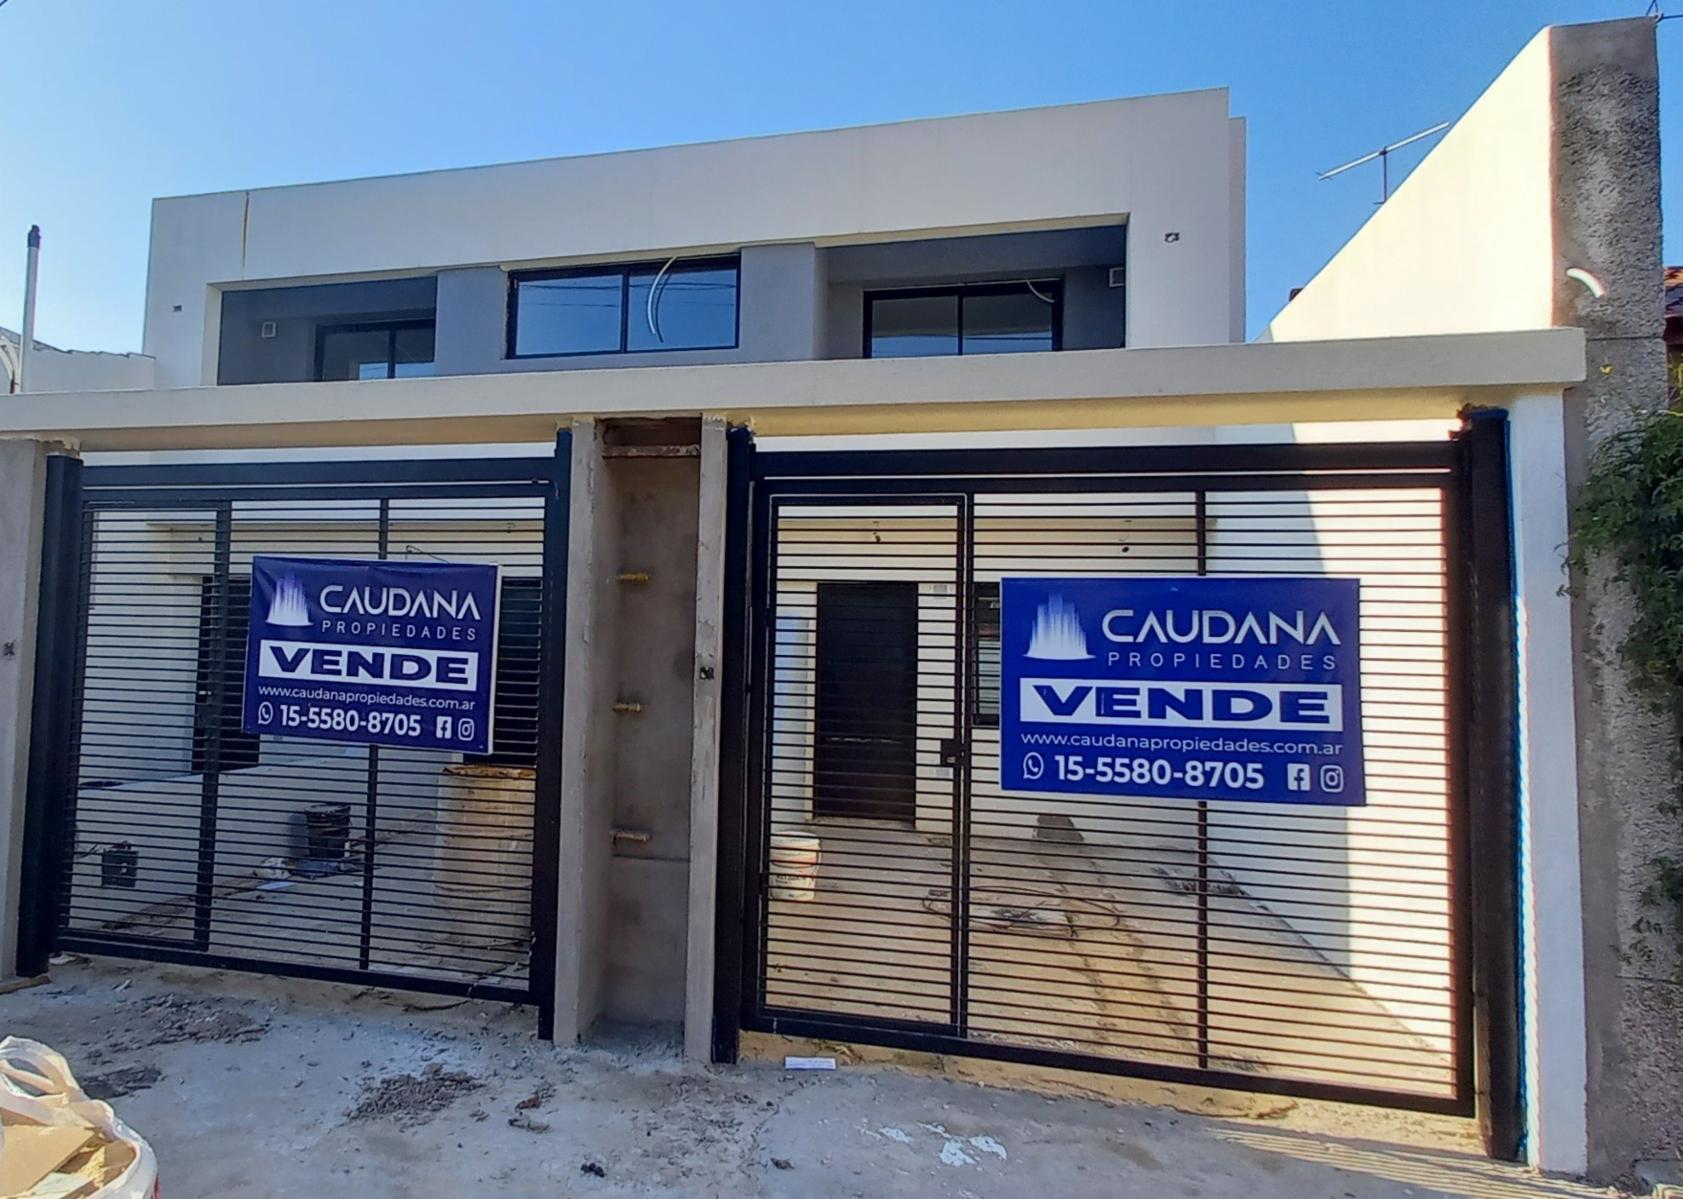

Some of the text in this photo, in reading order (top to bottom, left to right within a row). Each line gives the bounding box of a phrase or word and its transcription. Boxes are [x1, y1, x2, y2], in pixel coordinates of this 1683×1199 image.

[319, 585, 480, 620] CAUDANA
[321, 620, 477, 641] PROPIEDADES
[1102, 609, 1341, 645] CAUDANA
[269, 645, 470, 685] VENDE
[1108, 652, 1336, 670] PROPIEDADES
[258, 685, 475, 711] www.caudanapropiedades.com.ar
[1033, 685, 1330, 724] VENDE
[279, 704, 421, 736] 15-5580-8705
[1021, 732, 1342, 756] www.caudanapropiedades.com.ar
[1054, 755, 1264, 789] 15-5580-8705
